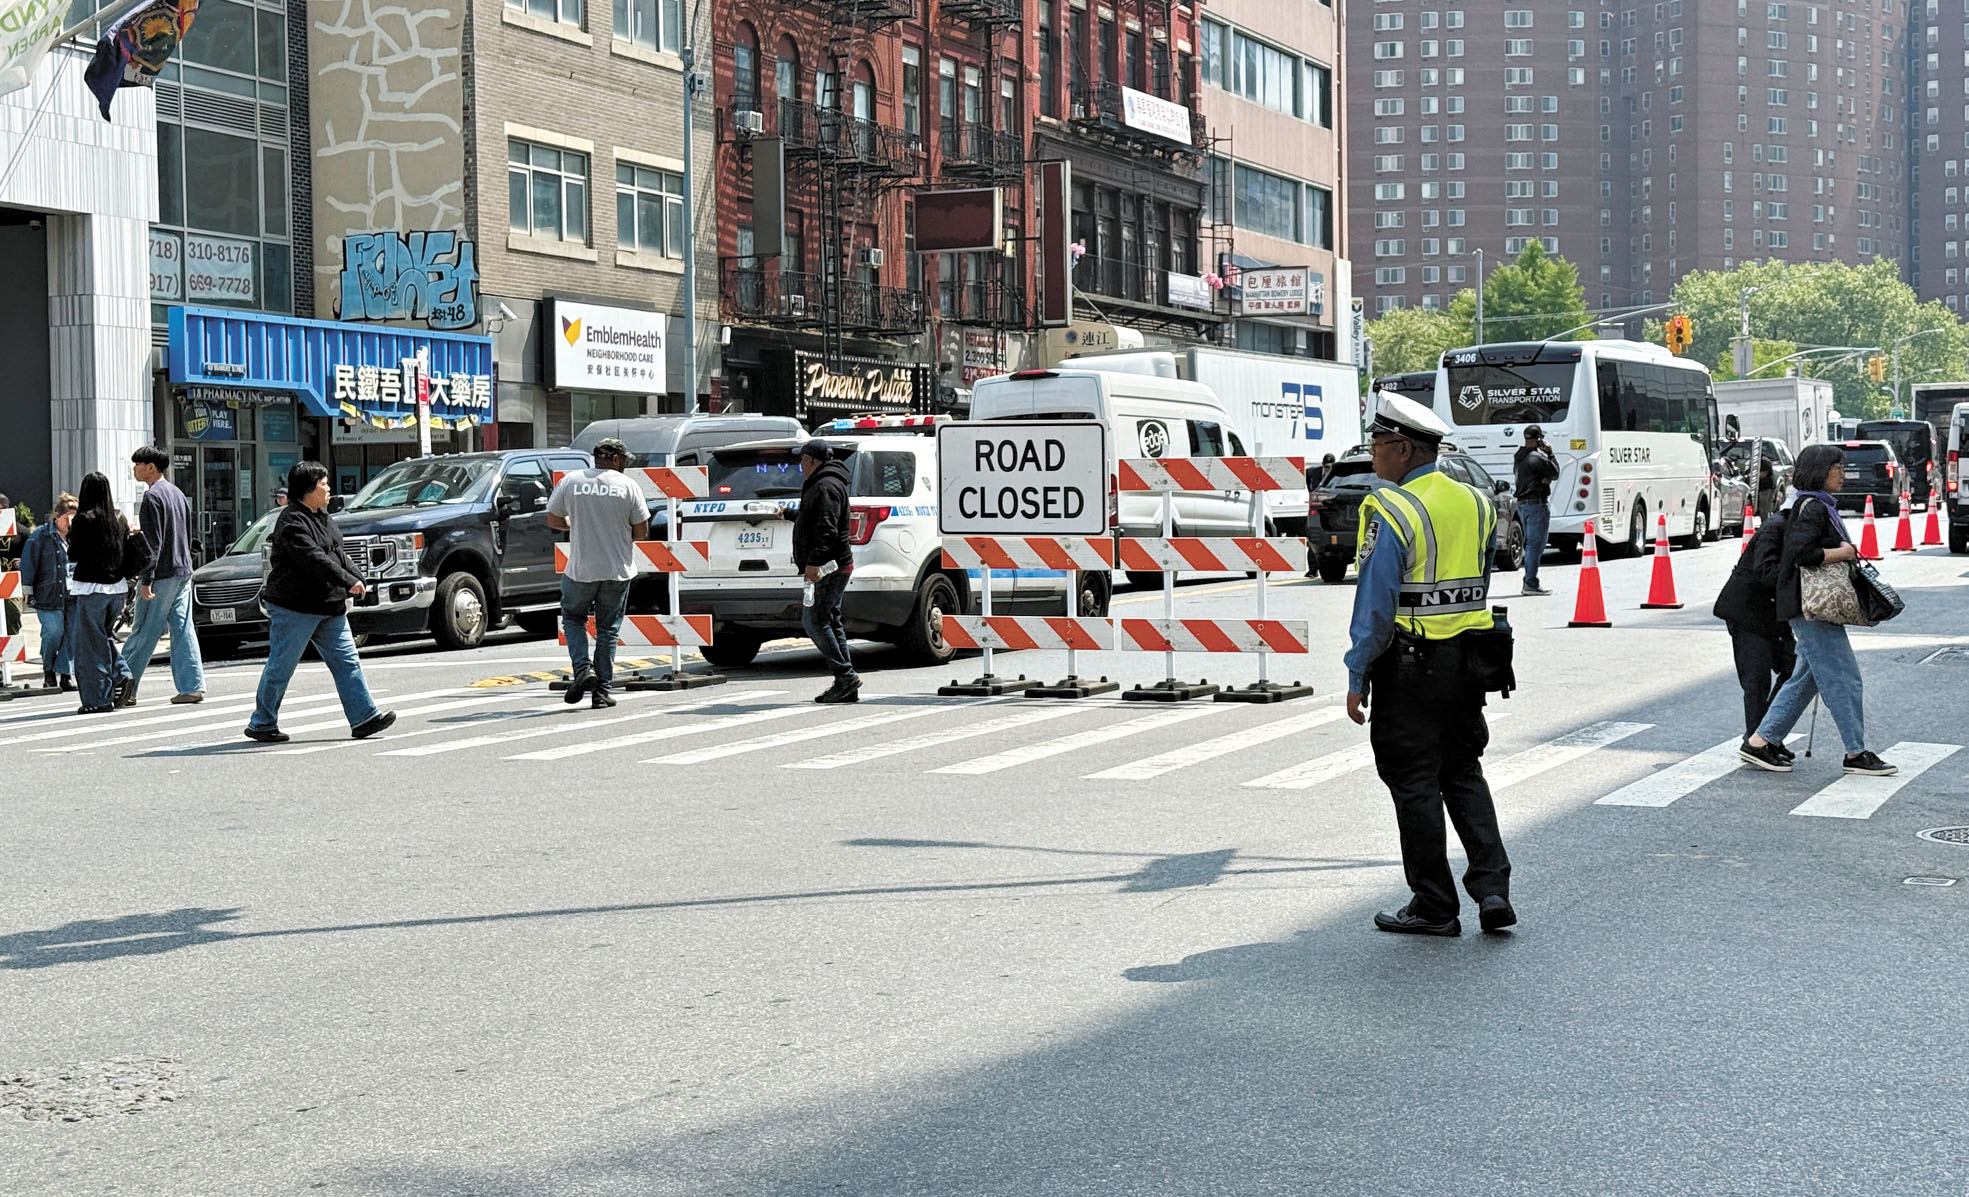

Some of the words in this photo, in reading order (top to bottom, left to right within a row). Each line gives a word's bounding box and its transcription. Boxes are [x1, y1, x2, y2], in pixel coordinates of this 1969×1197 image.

[188, 242, 250, 264] 310-8176
[189, 274, 251, 295] 669-7778
[1351, 314, 1362, 340] Valley
[586, 325, 661, 349] EmblemHealth
[587, 349, 637, 362] NEIGHBORHOOD
[638, 353, 654, 363] CARE
[1455, 353, 1477, 364] 3406
[806, 363, 865, 400] Phoenix
[865, 369, 913, 403] Palace
[203, 388, 249, 401] PHARMACY
[249, 391, 264, 402] INC
[1487, 388, 1526, 396] SILVER
[1530, 387, 1561, 395] STAR
[1487, 395, 1561, 404] TRANSPORTATION
[975, 439, 1065, 472] ROAD
[1609, 448, 1632, 463] SILVER
[1634, 448, 1651, 463] STAR
[573, 483, 628, 497] LOADER
[693, 503, 726, 513] NYPD
[959, 486, 1084, 519] CLOSED
[738, 533, 761, 544] 4235
[1421, 586, 1484, 606] NYPD
